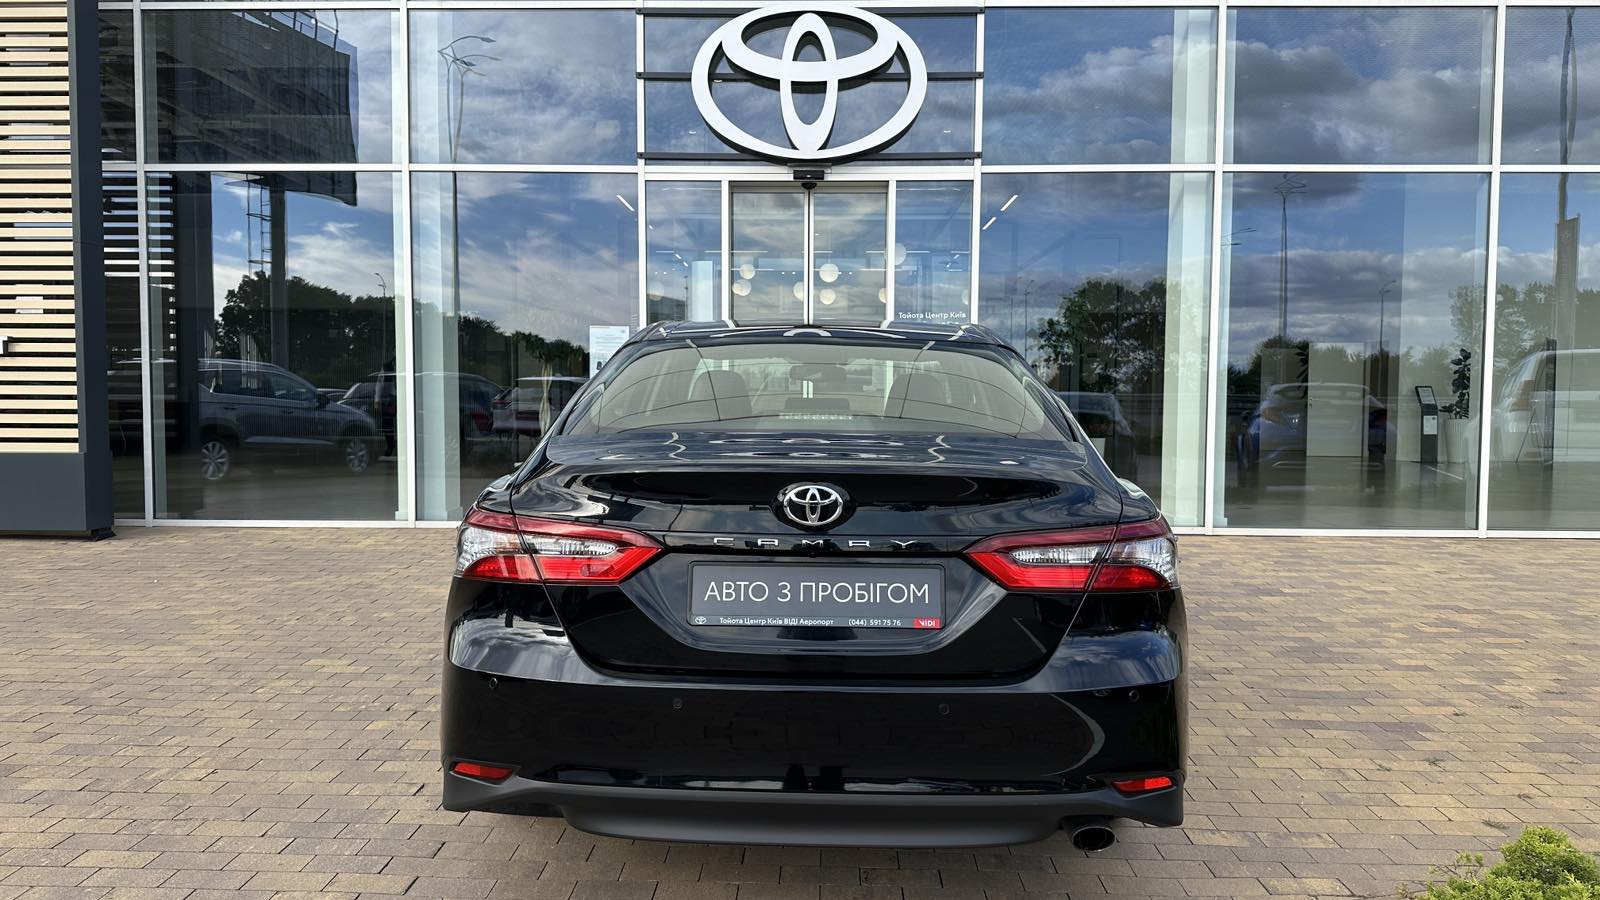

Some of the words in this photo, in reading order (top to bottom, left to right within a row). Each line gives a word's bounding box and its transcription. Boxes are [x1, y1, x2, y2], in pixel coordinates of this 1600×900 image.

[898, 311, 924, 319] Тойота
[925, 311, 949, 320] Центр
[950, 311, 967, 319] Київ
[713, 536, 918, 549] CAMRY
[703, 580, 769, 602] АВТО
[799, 582, 930, 604] ПРОБІГОМ
[719, 617, 743, 625] Тойота
[744, 617, 767, 626] Центр
[767, 617, 783, 625] Київ
[799, 618, 834, 627] Аеропорт
[848, 618, 867, 626] (044)
[917, 619, 936, 627] VIDI
